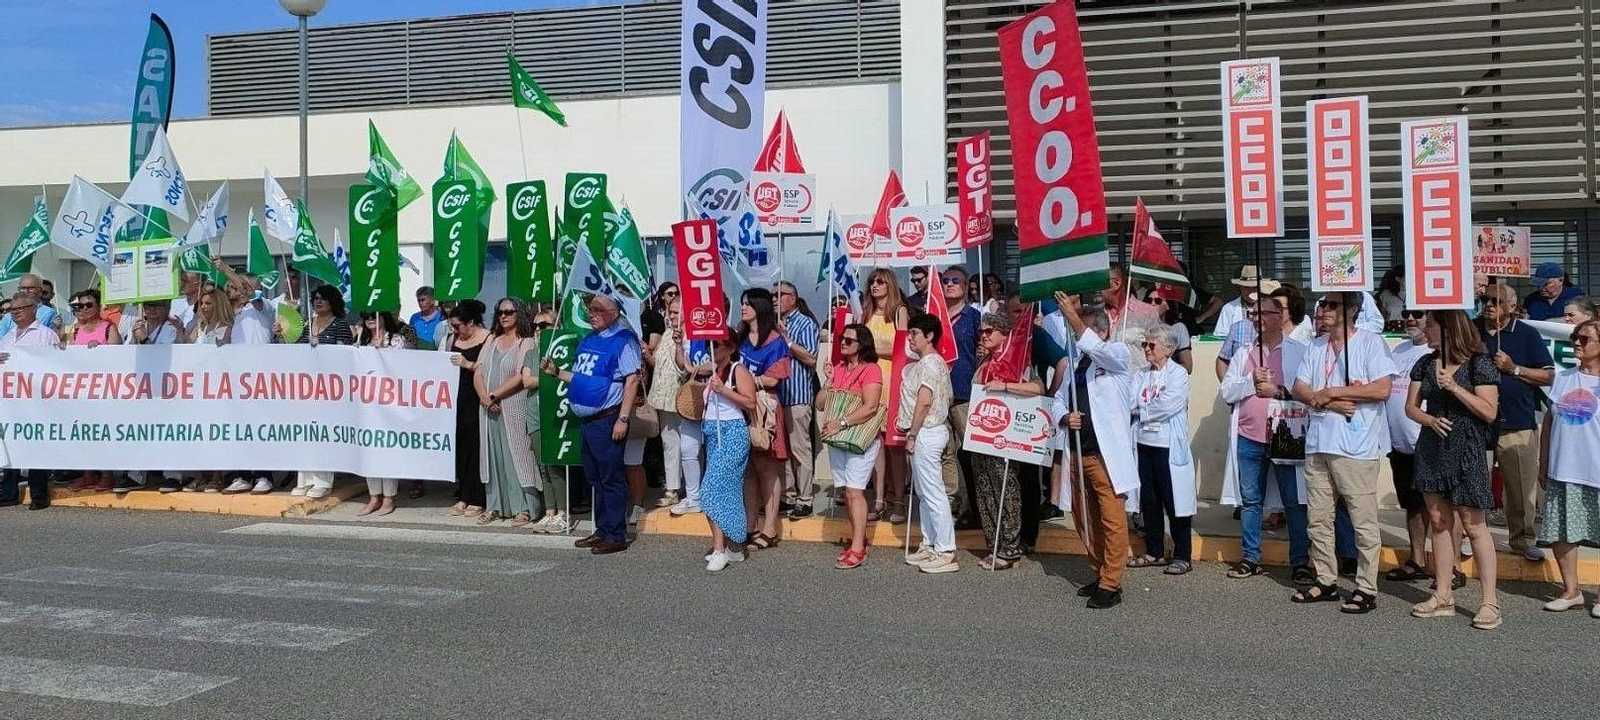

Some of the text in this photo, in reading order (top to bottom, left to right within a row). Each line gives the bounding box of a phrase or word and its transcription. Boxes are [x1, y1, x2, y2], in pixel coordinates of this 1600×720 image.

[443, 193, 471, 208] CSIF
[517, 195, 542, 210] CSIF
[575, 187, 601, 199] CSIF
[965, 138, 988, 214] UGT
[1239, 116, 1268, 227] CCOO
[1323, 109, 1353, 229] CCOO
[366, 228, 382, 307] CSIF
[448, 221, 462, 296] CSIF
[525, 223, 542, 298] CSIF
[684, 225, 716, 305] UGT
[1422, 179, 1453, 297] CCOO
[1473, 256, 1520, 265] SANIDAD
[2, 370, 453, 409] EN DEFENSA DE LA SANIDAD PÚBLICA
[978, 402, 1007, 420] UGT
[13, 422, 45, 440] POR
[49, 422, 66, 440] EL
[70, 419, 111, 441] ÁREA
[115, 423, 203, 441] SANITARIA
[209, 423, 230, 441] DE
[236, 423, 253, 441] LA
[258, 420, 330, 443] CAMPIÑA
[333, 425, 356, 444] SUR
[357, 428, 452, 451] CORDOBESA
